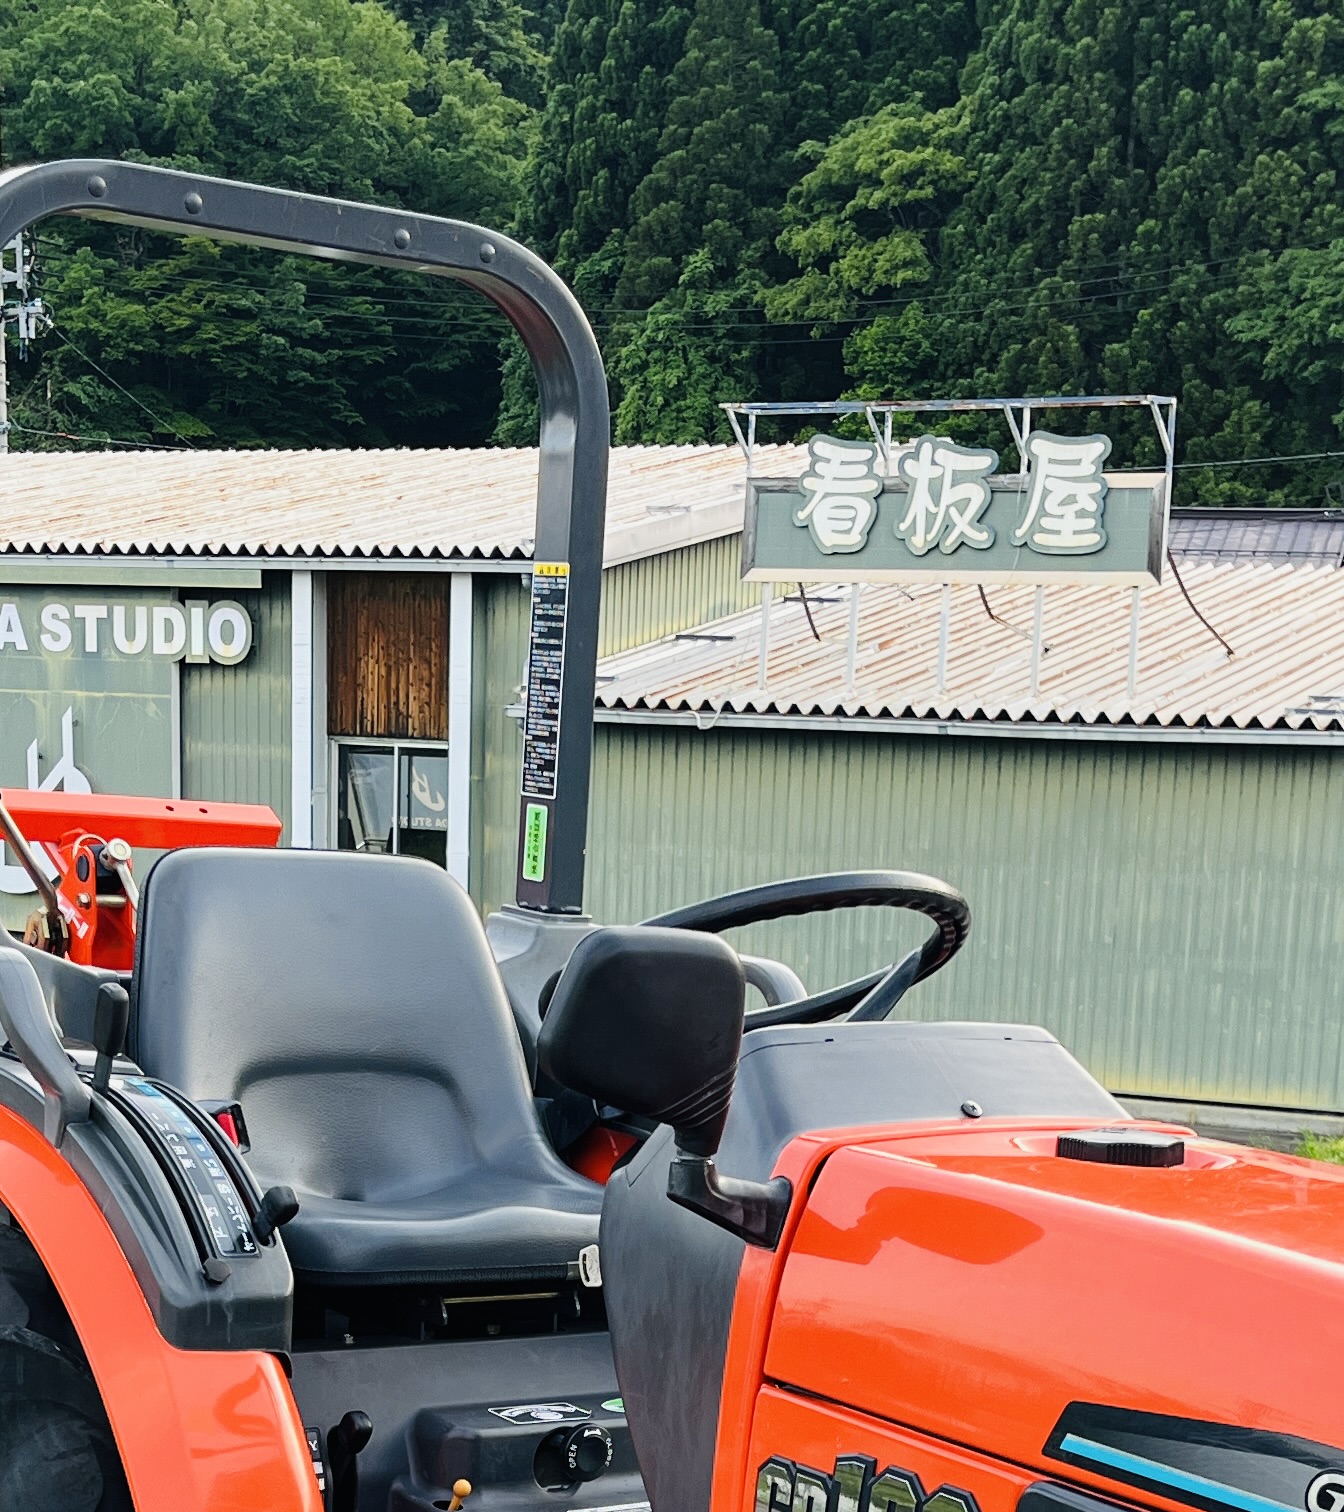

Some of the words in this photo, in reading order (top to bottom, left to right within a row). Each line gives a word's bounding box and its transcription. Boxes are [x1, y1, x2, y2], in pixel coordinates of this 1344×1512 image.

[796, 438, 1105, 550] 看板屋
[41, 602, 250, 657] STUDIO
[568, 1444, 578, 1469] OPEN
